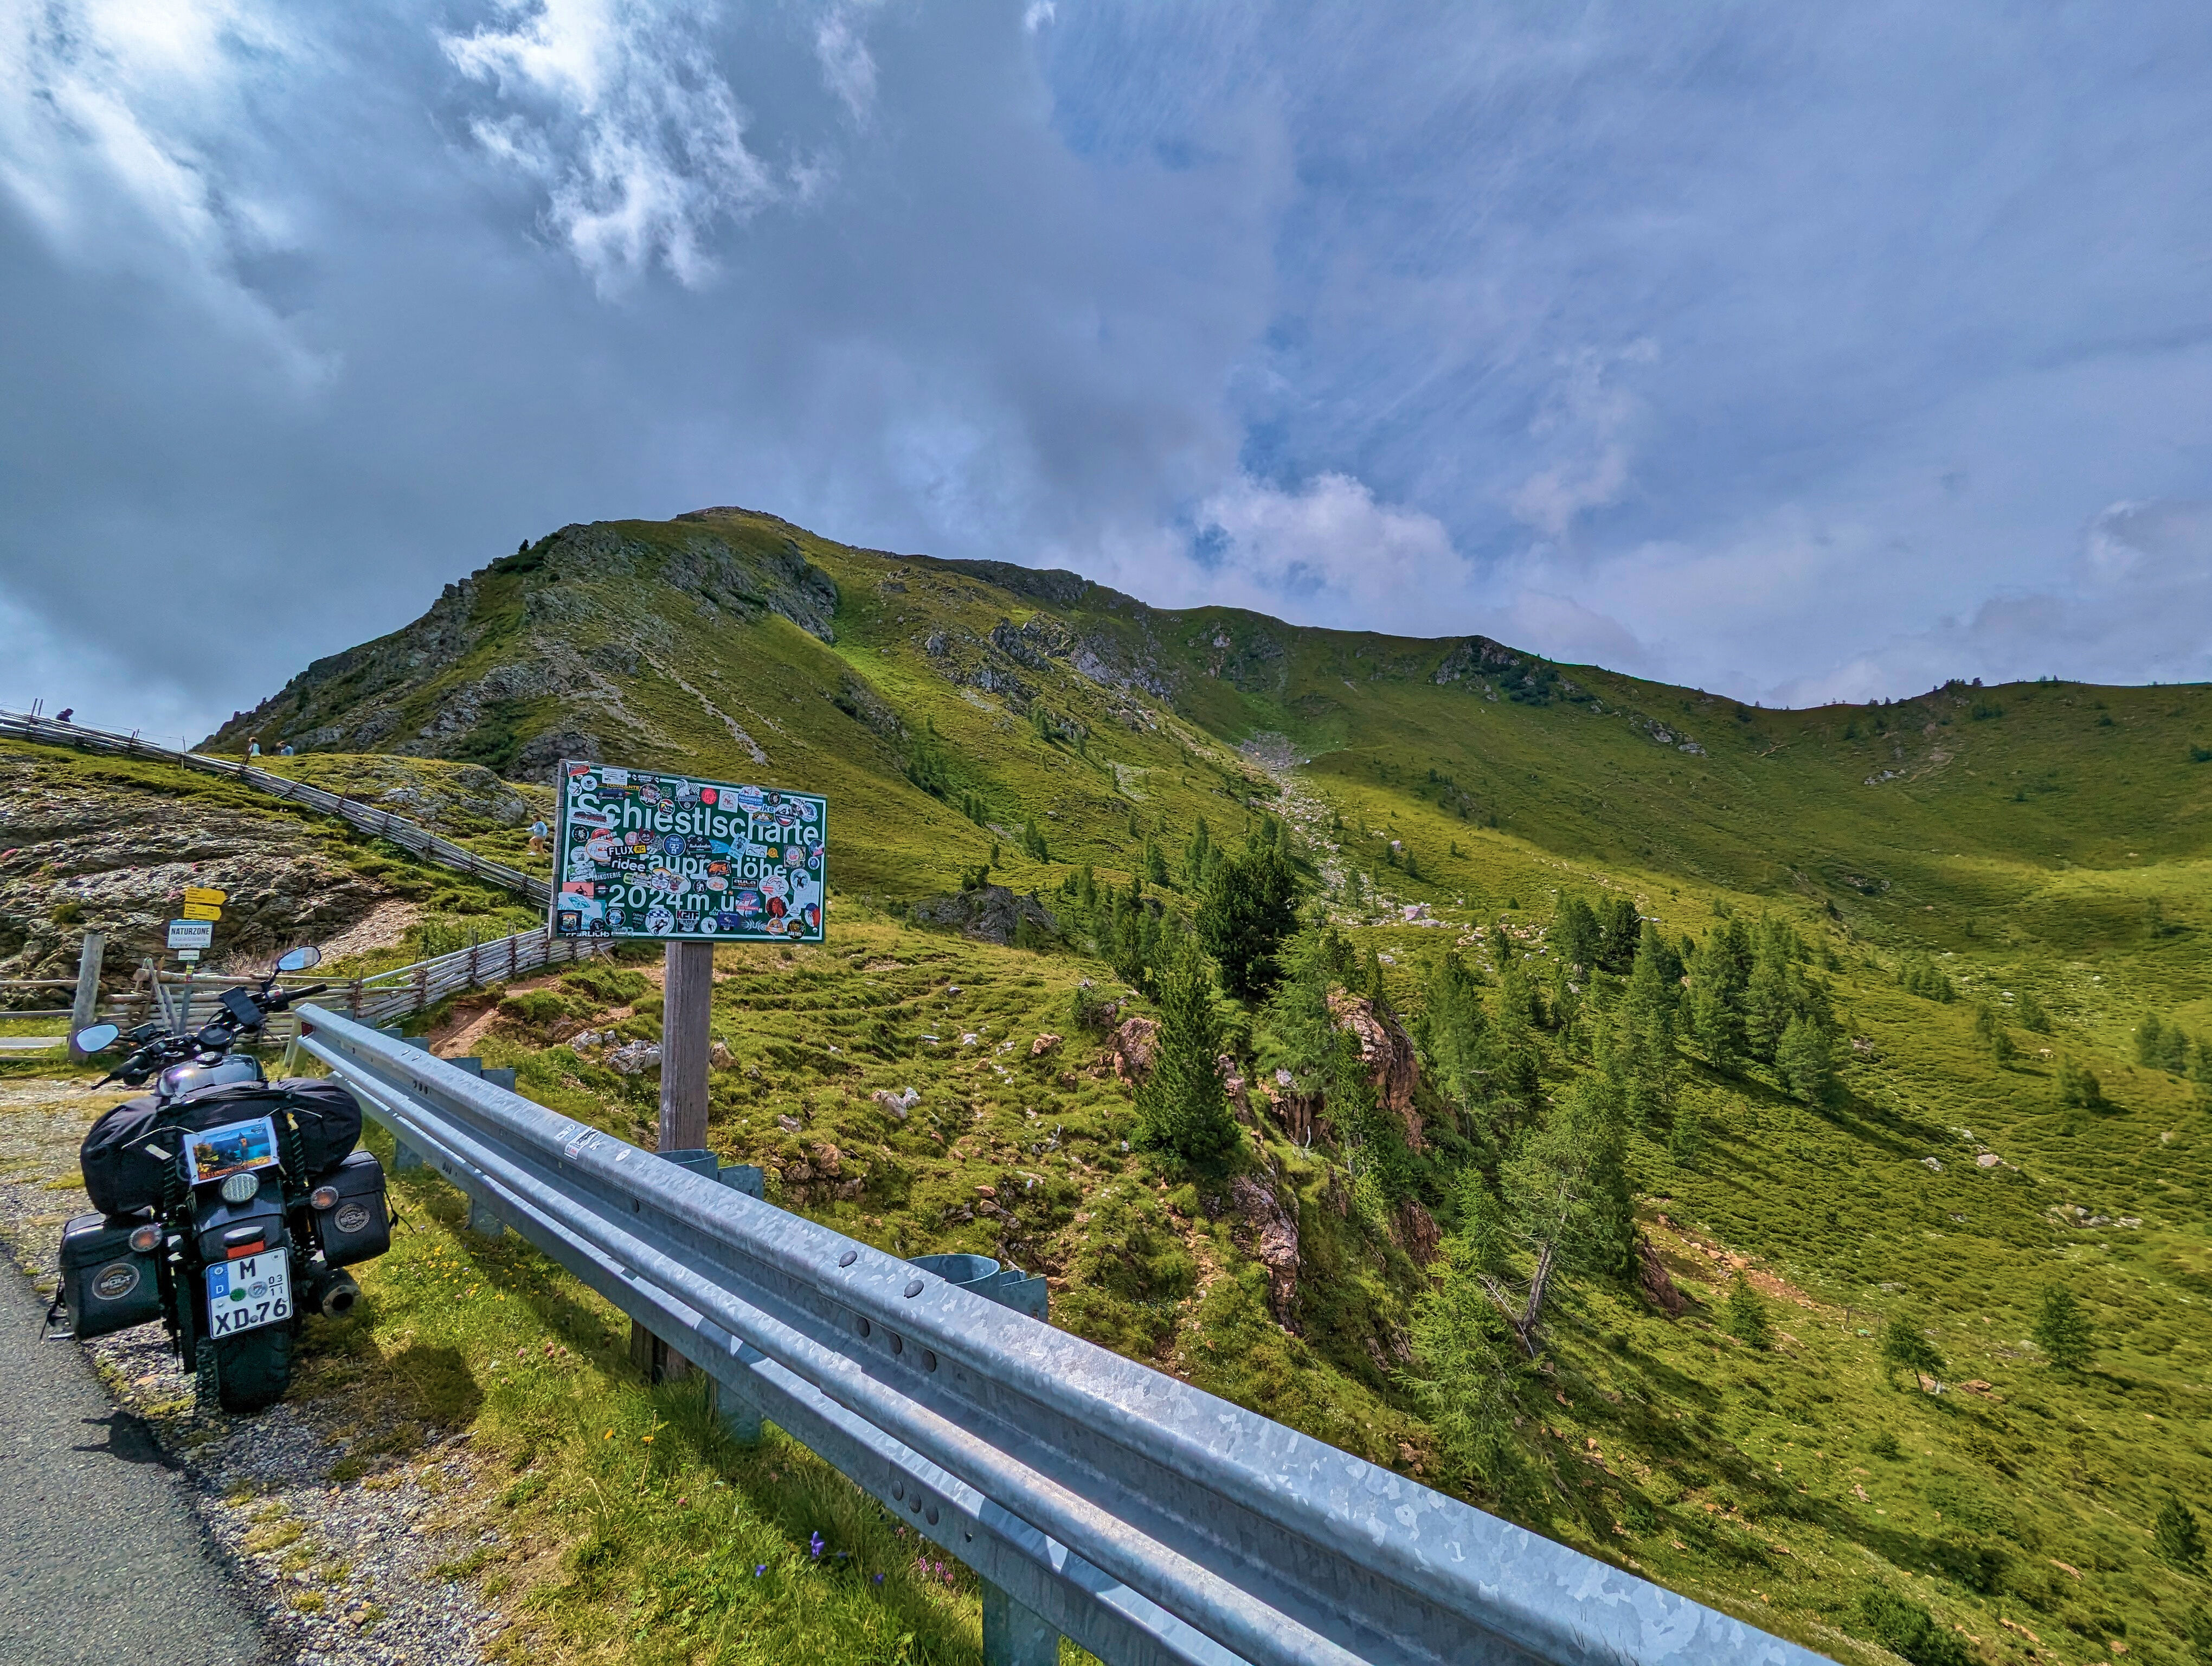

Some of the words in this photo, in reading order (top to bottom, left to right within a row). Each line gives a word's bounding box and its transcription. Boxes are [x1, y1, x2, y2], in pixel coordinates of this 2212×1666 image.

[577, 793, 819, 845] Schiestlscharte
[608, 846, 633, 856] FLUX
[611, 858, 646, 872] ridee
[608, 883, 683, 910] 2024
[687, 894, 710, 911] m
[240, 1258, 256, 1280] M
[268, 1274, 282, 1284] 03
[216, 1285, 224, 1294] D
[271, 1286, 283, 1296] 11
